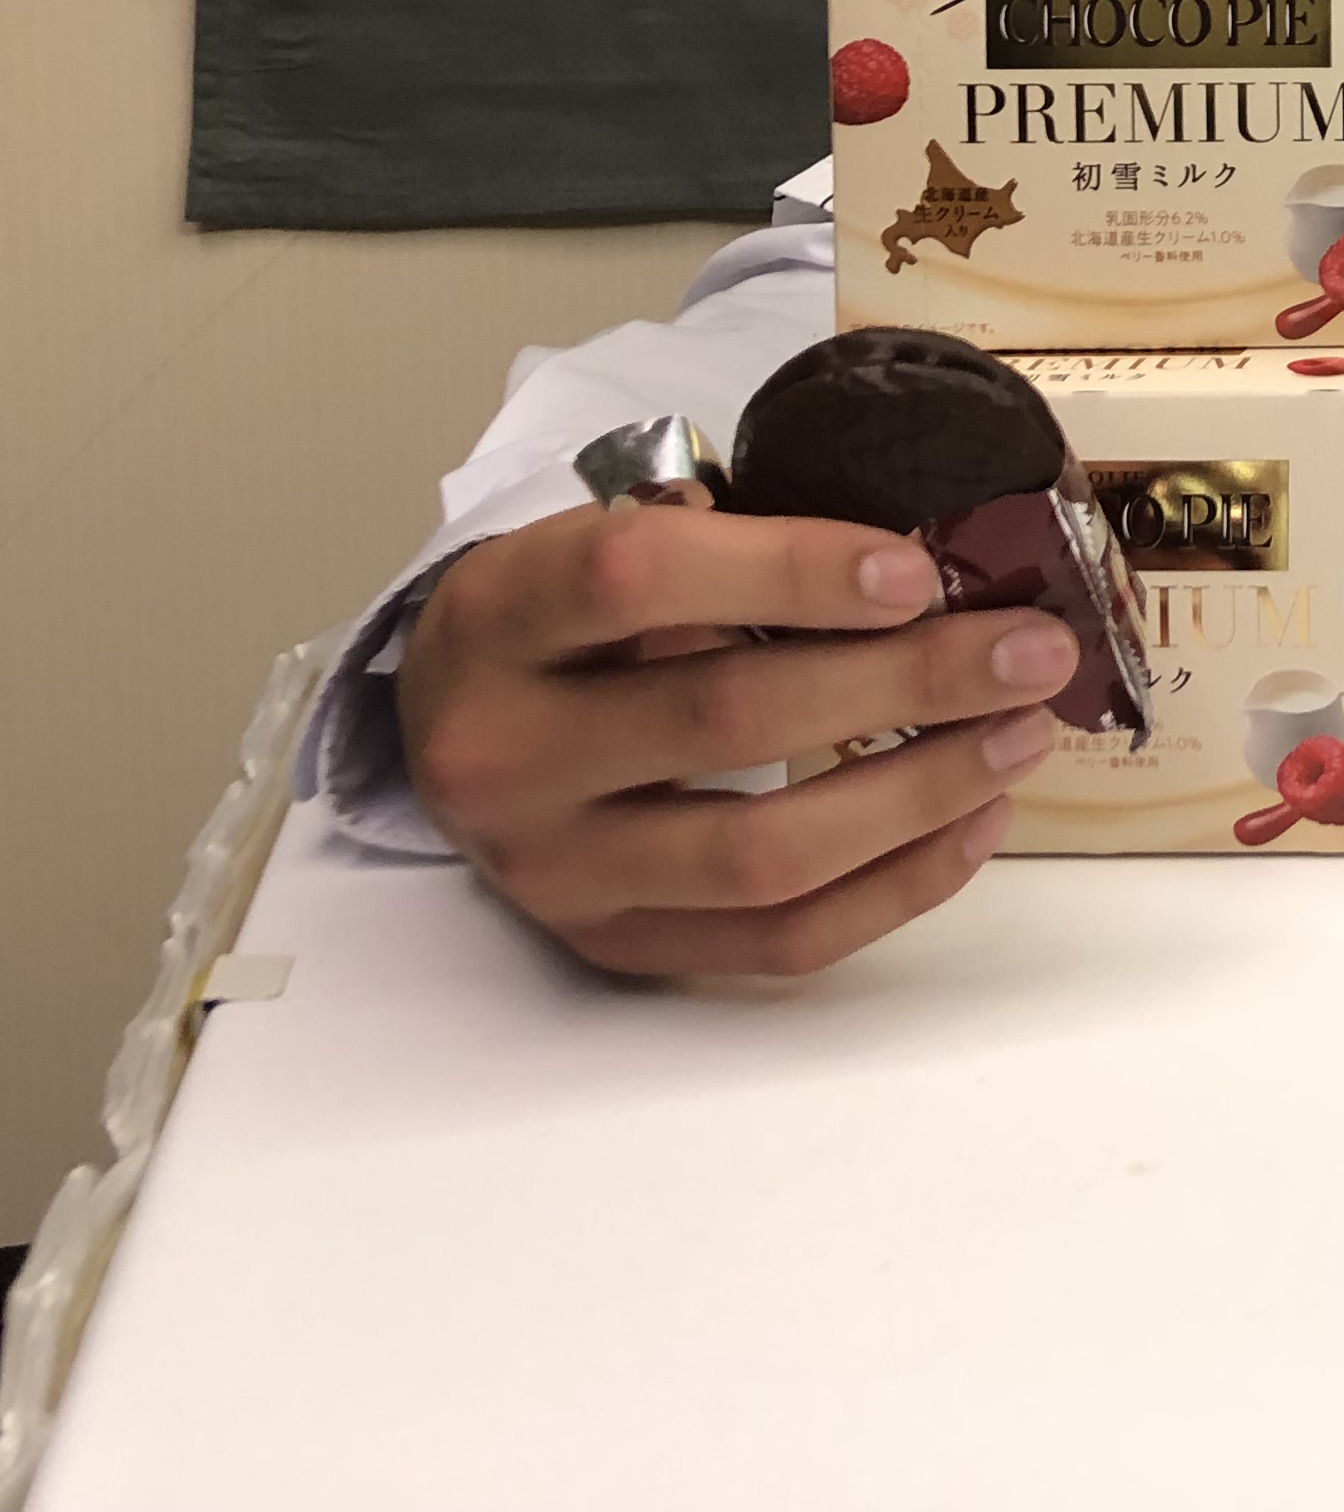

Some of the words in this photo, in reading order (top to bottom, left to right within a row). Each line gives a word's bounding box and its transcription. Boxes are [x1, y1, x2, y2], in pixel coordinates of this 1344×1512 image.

[1071, 161, 1238, 192] 初雪ミルク
[913, 204, 999, 224] 生クリーム
[1088, 470, 1147, 485] OTTE
[1180, 492, 1274, 549] PIE
